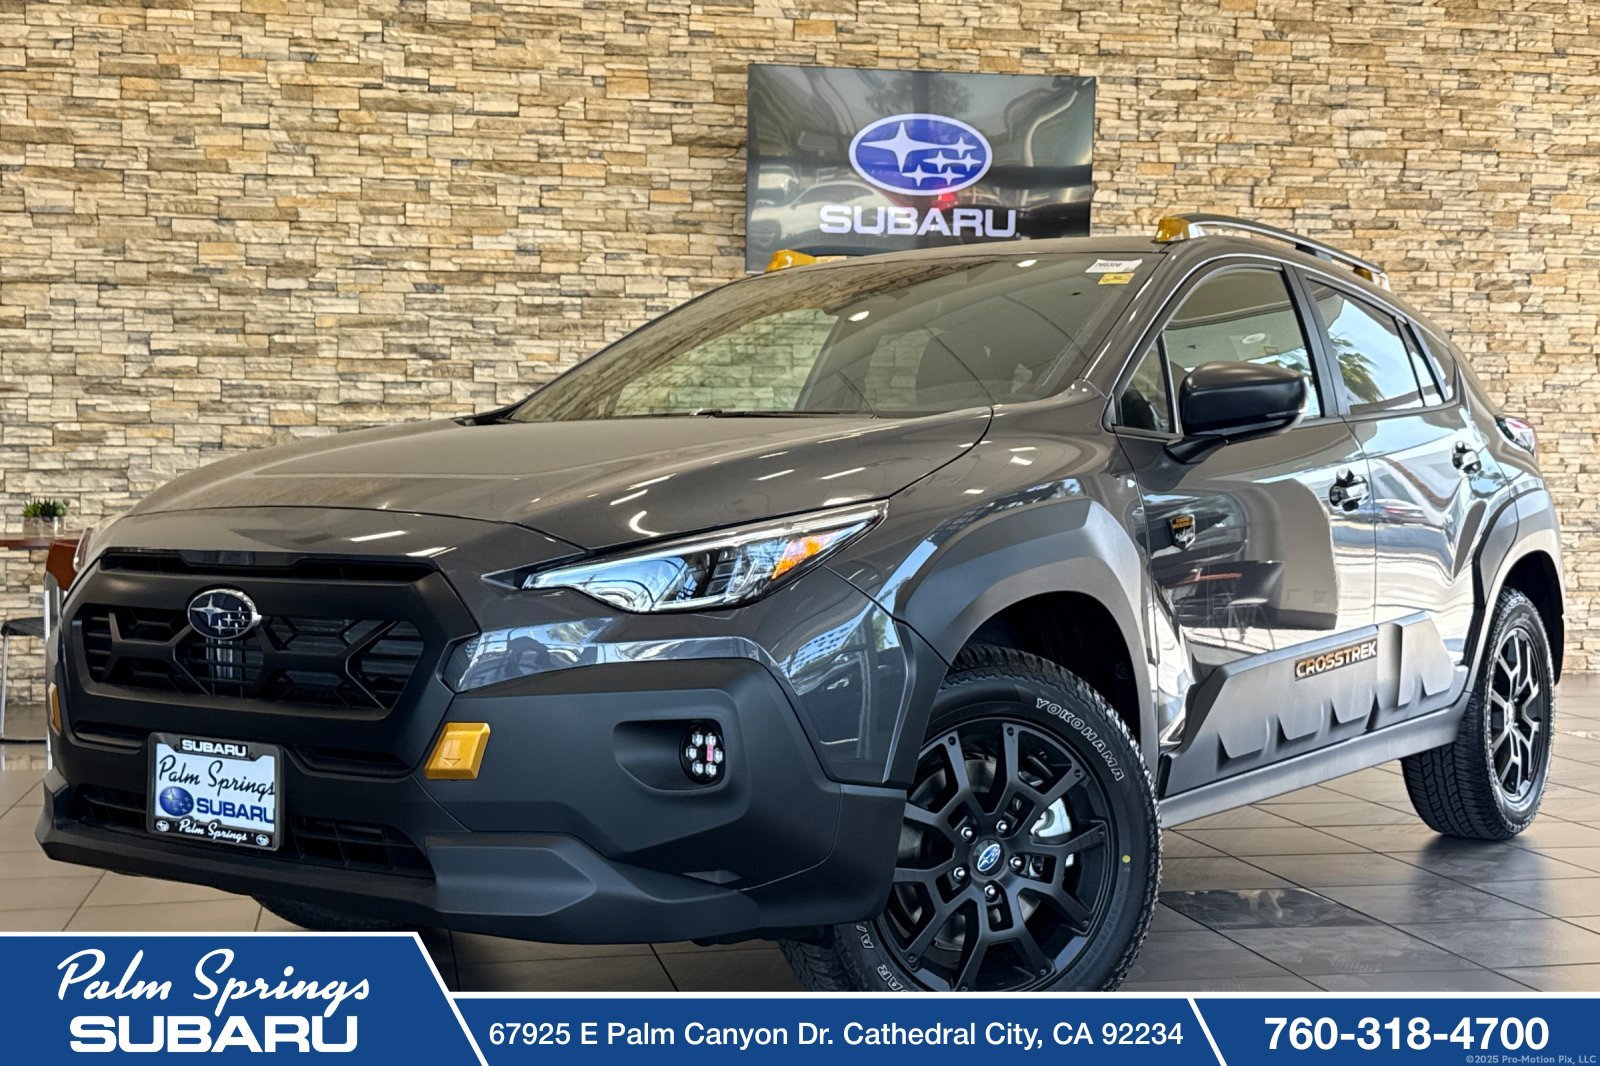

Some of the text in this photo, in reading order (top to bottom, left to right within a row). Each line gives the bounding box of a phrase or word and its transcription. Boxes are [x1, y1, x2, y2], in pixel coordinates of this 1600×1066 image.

[820, 204, 1017, 238] SUBARU
[1296, 641, 1377, 678] CROSSTREK
[182, 740, 246, 756] SUBARU
[1036, 698, 1125, 781] YOKOHAMA
[159, 755, 275, 802] Palm Springs
[196, 797, 275, 824] SUBARU
[179, 818, 247, 843] Palm Springs
